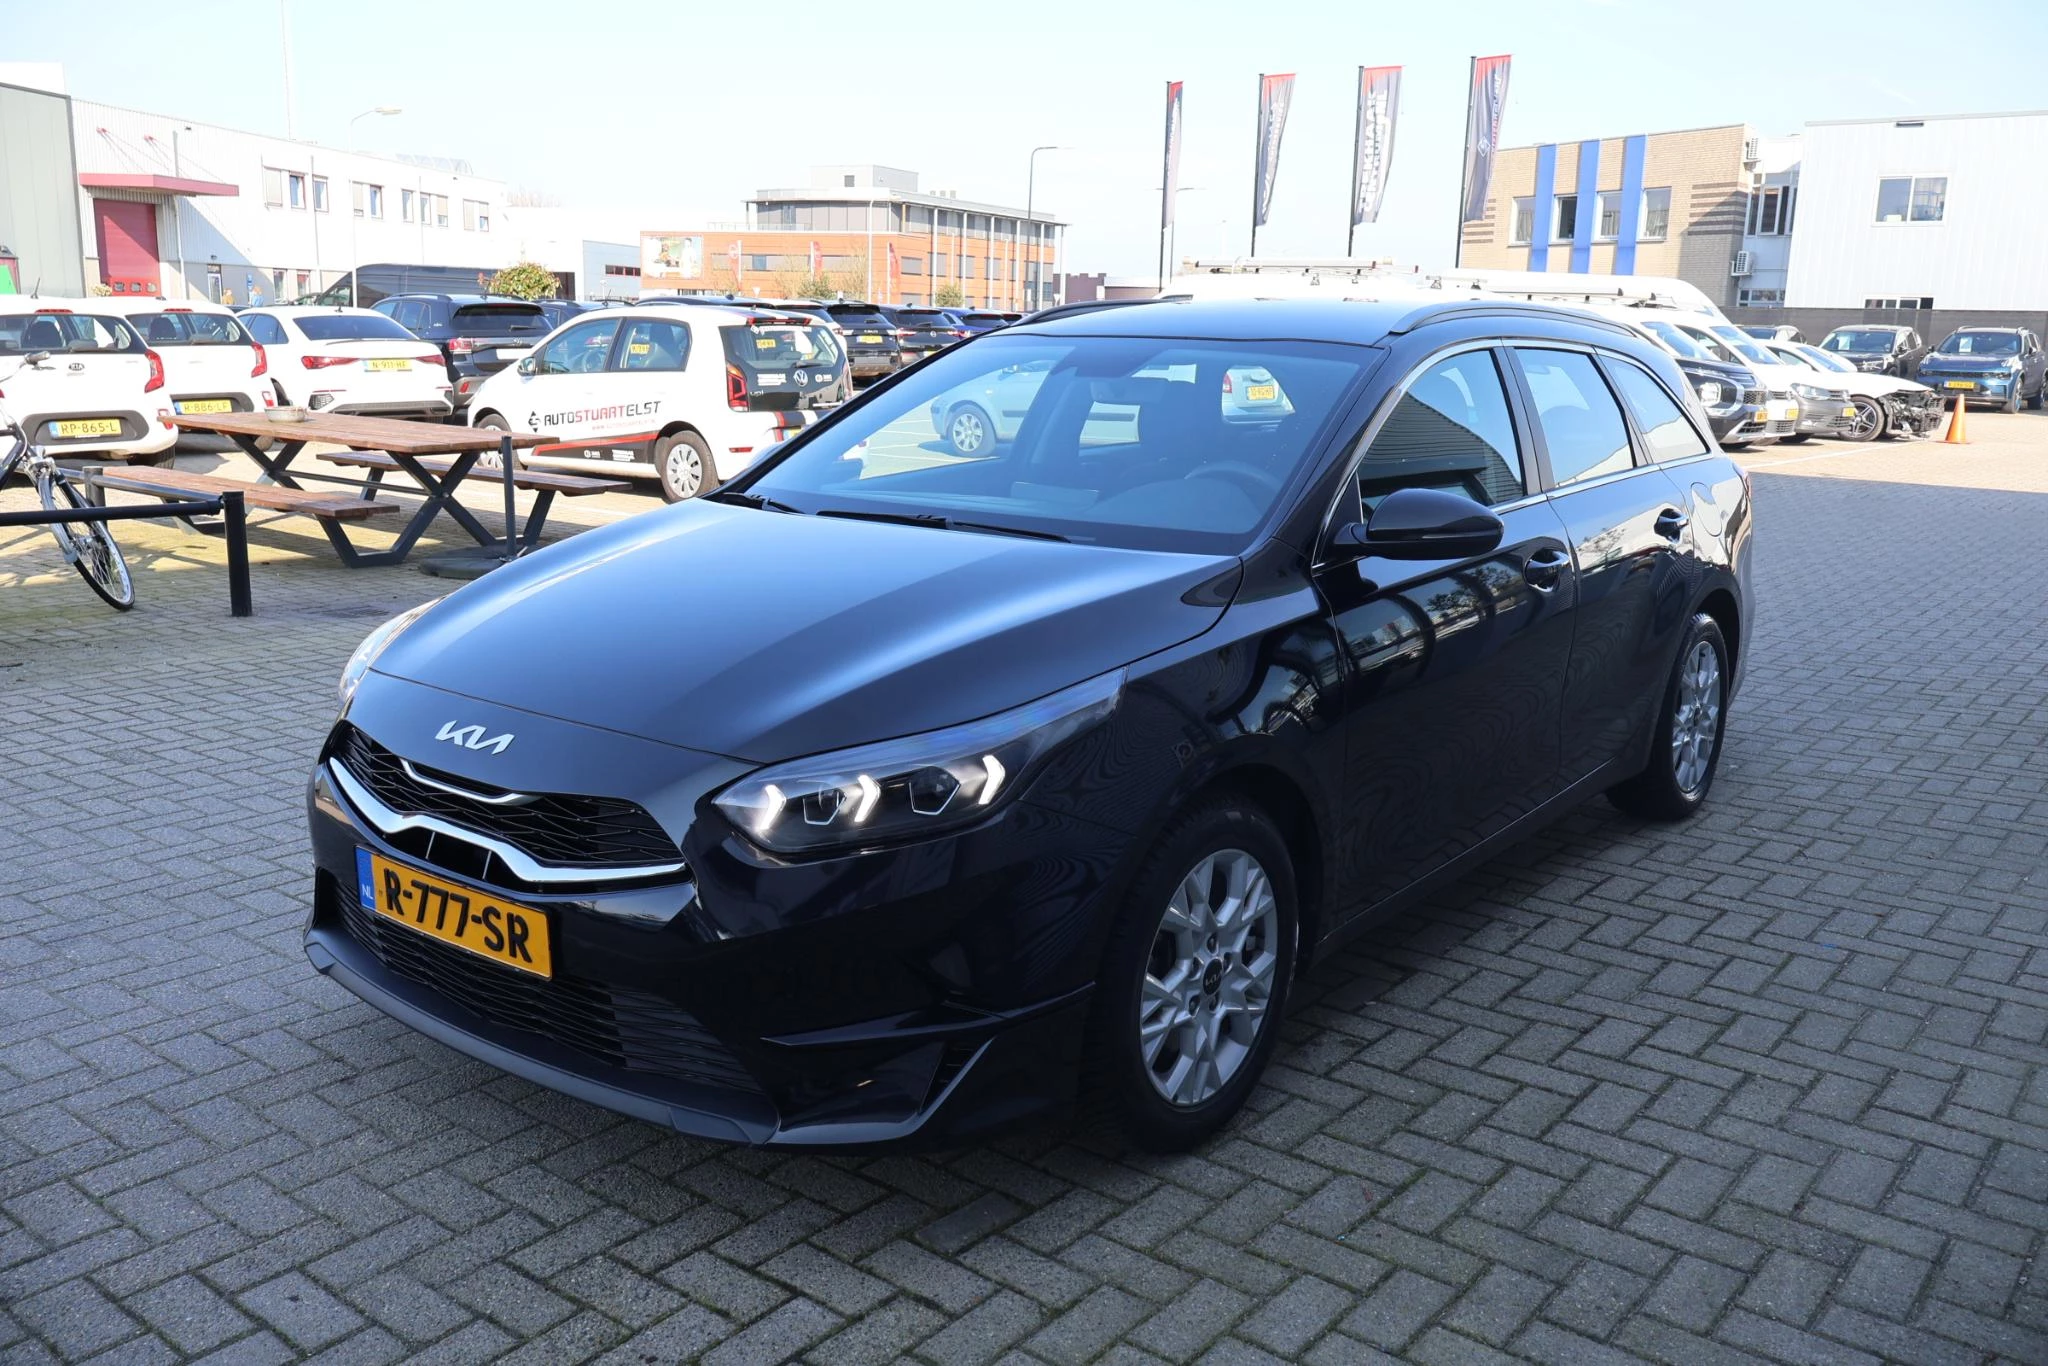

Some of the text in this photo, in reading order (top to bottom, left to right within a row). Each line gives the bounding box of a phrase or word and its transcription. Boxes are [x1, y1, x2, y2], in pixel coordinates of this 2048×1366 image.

[61, 421, 117, 434] RP-865-L
[362, 868, 533, 963] NL R-777-SR
